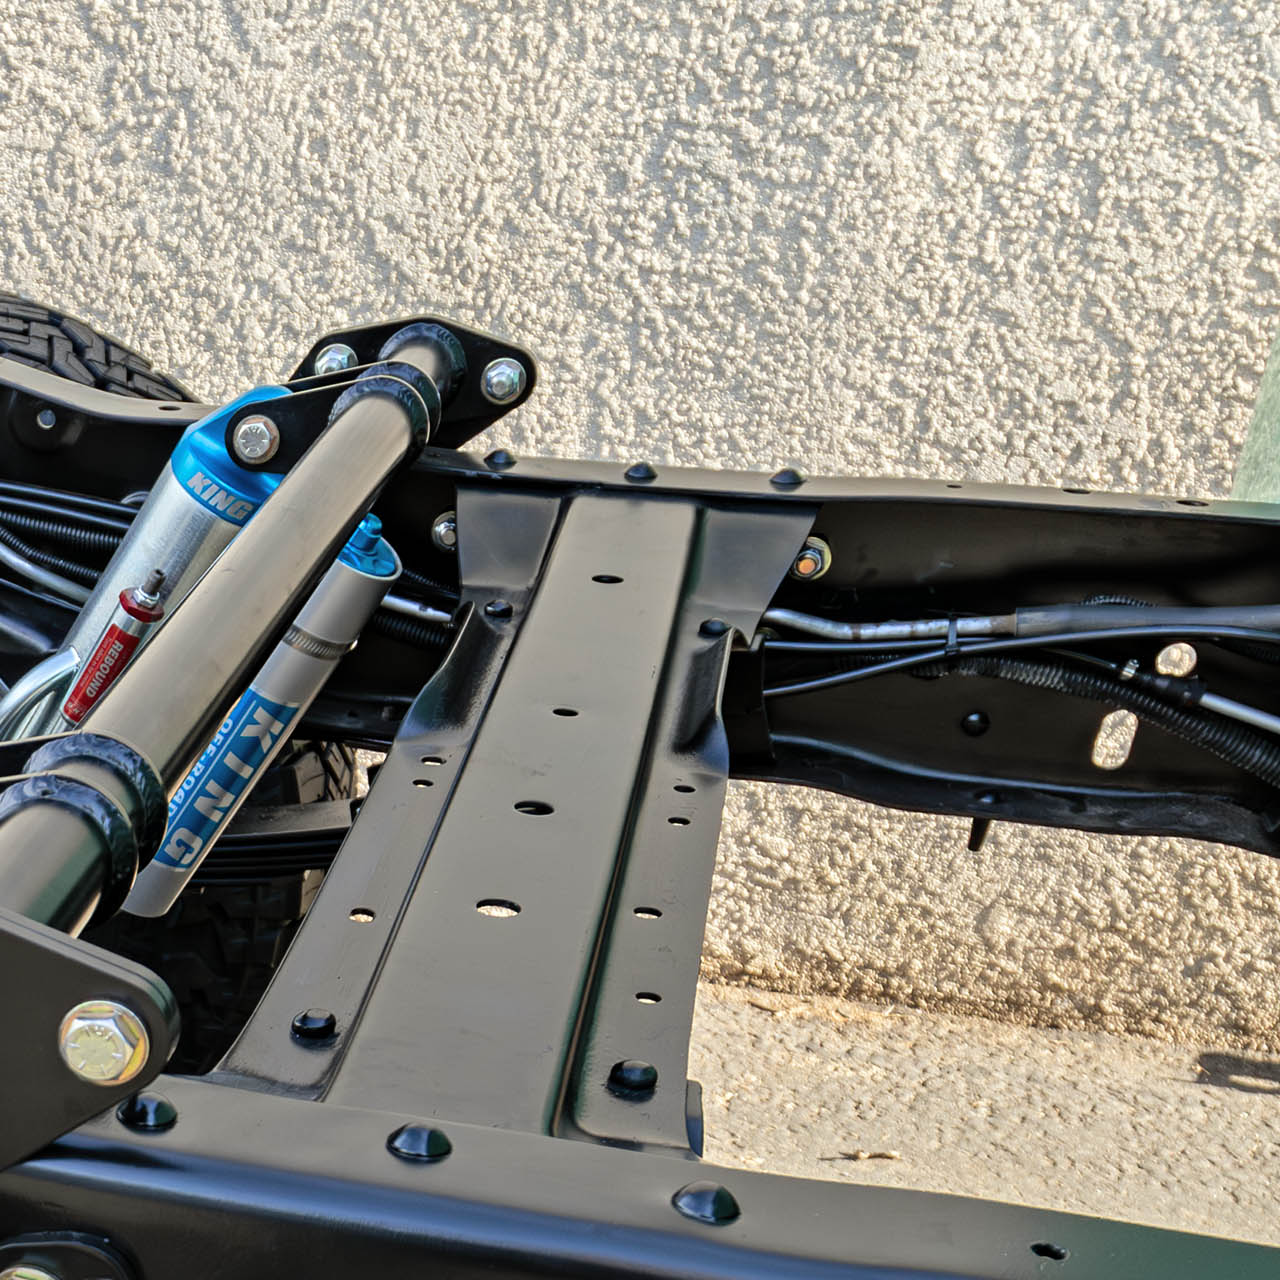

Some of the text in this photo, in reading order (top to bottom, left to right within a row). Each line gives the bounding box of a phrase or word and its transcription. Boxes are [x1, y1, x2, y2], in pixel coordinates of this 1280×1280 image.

[187, 472, 253, 520] KING
[86, 640, 124, 698] REBOUND
[164, 706, 285, 865] KING
